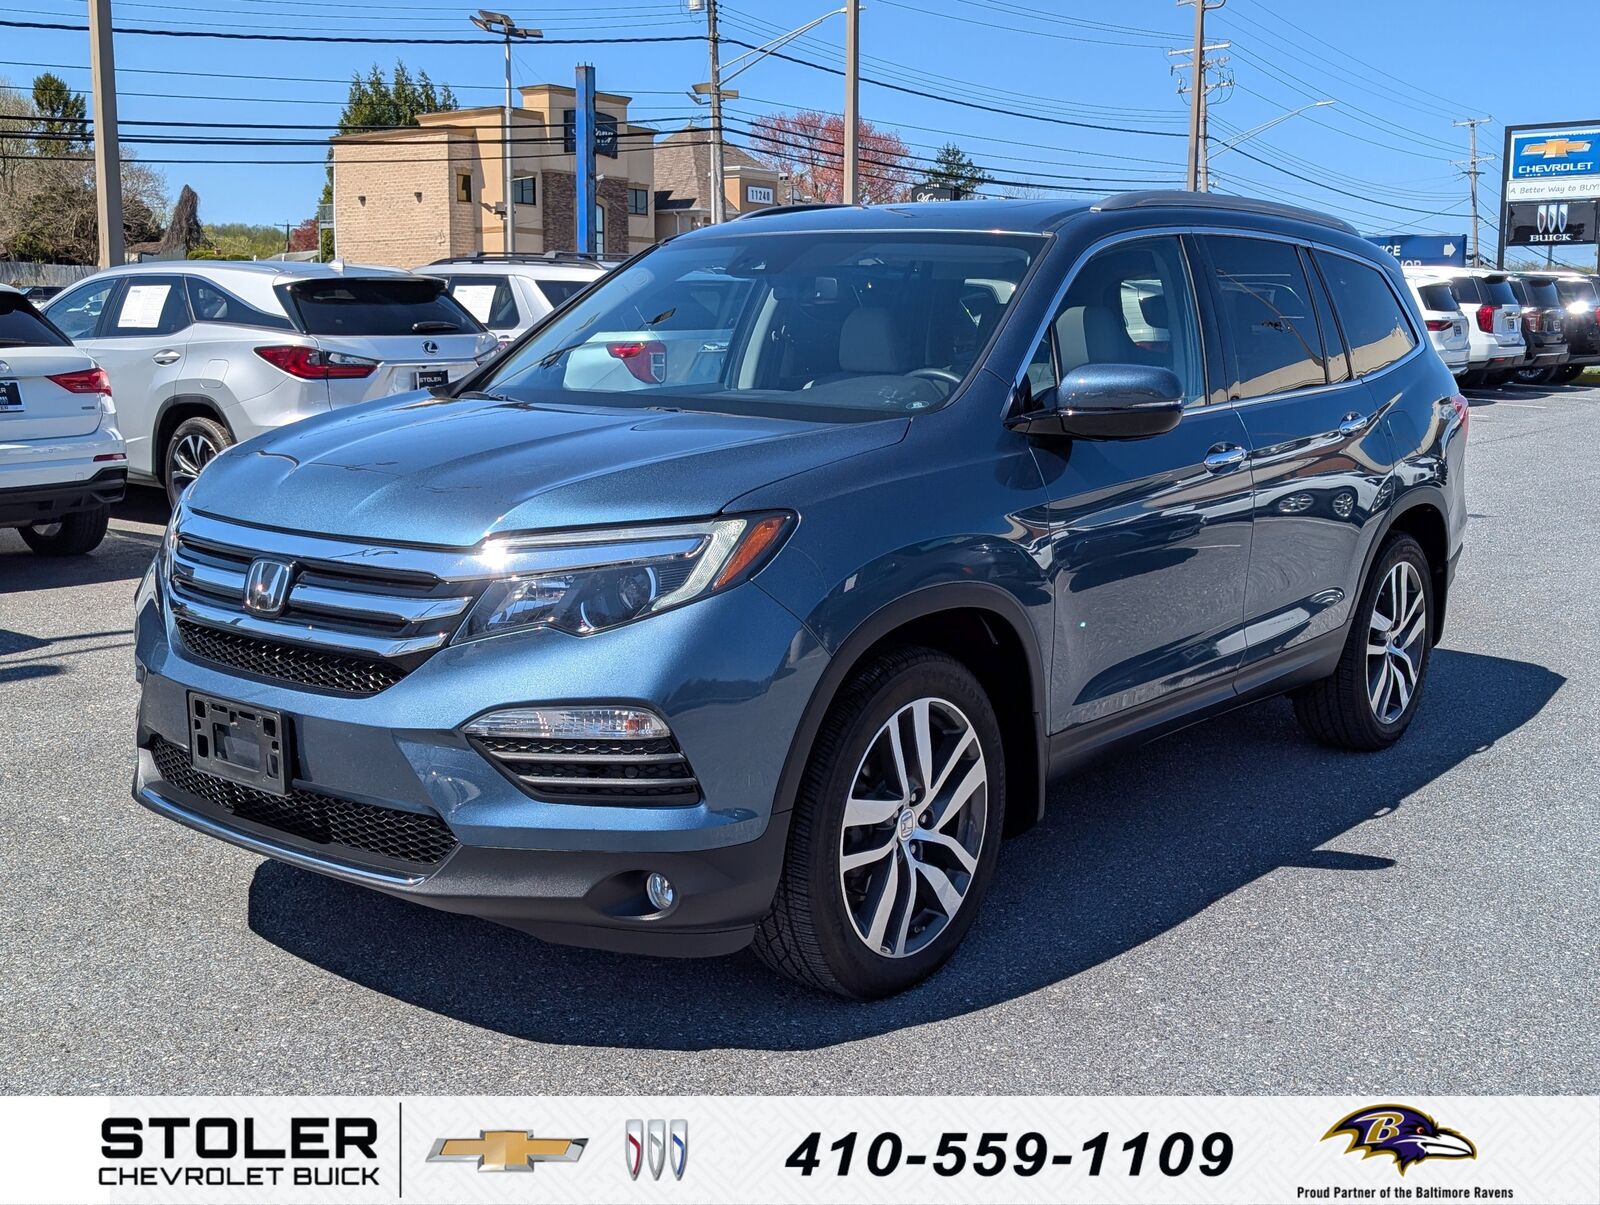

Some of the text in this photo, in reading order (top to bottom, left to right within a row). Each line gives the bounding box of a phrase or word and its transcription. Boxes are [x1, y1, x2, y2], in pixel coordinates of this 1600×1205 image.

[1518, 162, 1594, 174] CHEVROLET
[1520, 186, 1545, 194] Better
[1548, 185, 1565, 194] Way
[751, 189, 771, 201] 11240
[1529, 233, 1573, 242] BUICK
